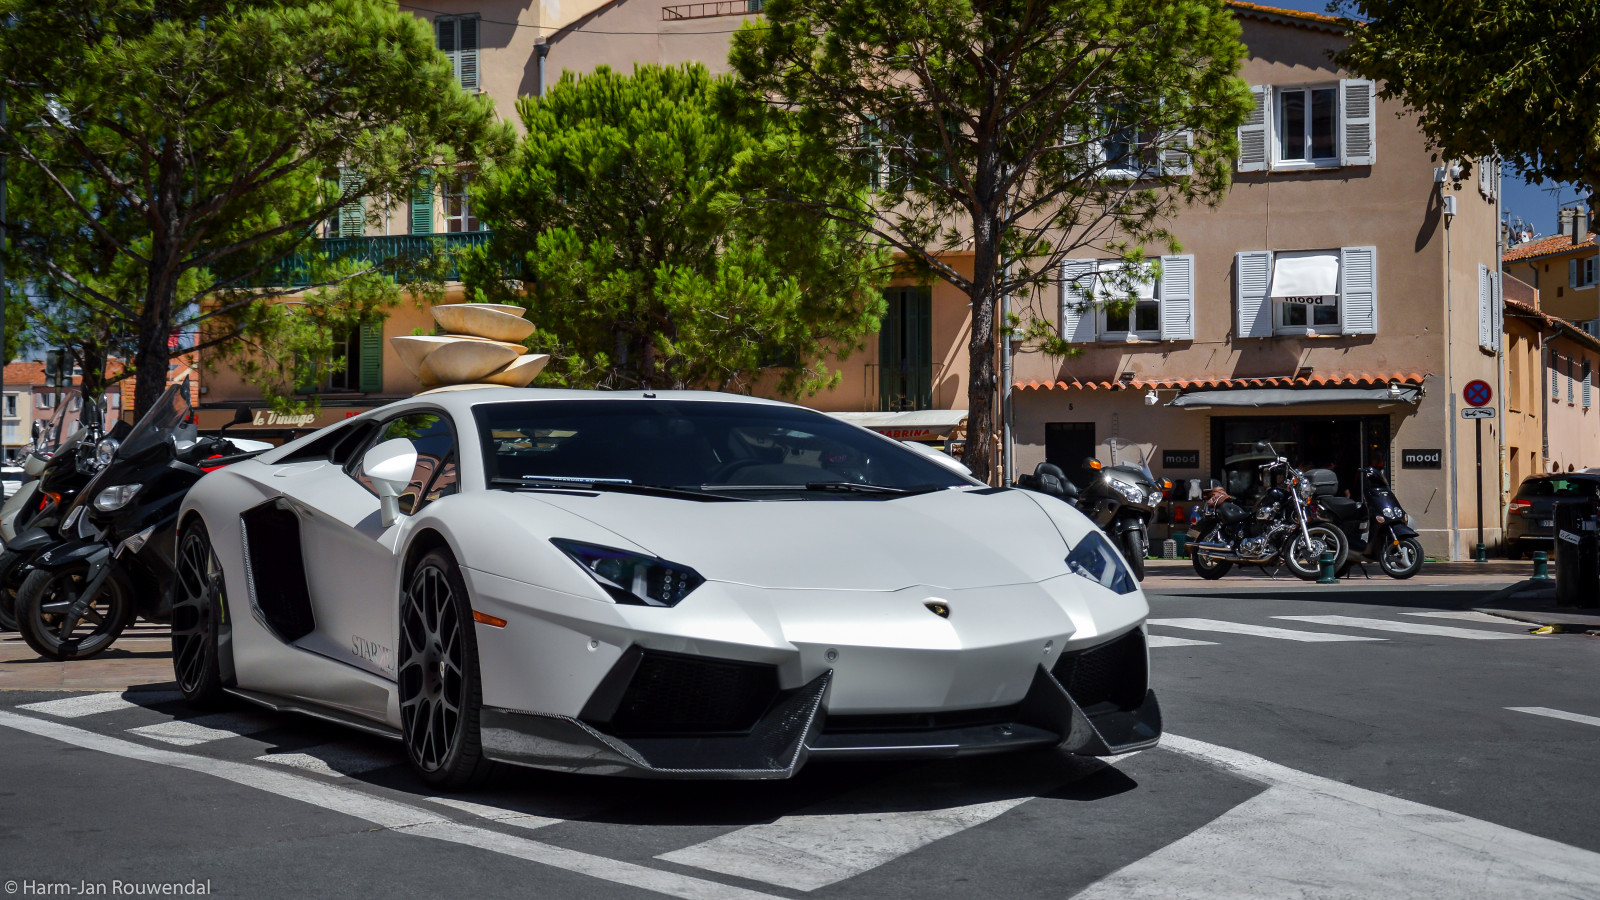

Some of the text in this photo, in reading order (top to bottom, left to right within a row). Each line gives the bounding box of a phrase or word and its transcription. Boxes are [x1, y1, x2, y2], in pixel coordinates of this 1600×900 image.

[1285, 296, 1323, 305] mood
[1166, 454, 1196, 463] mood
[1406, 453, 1439, 462] mood
